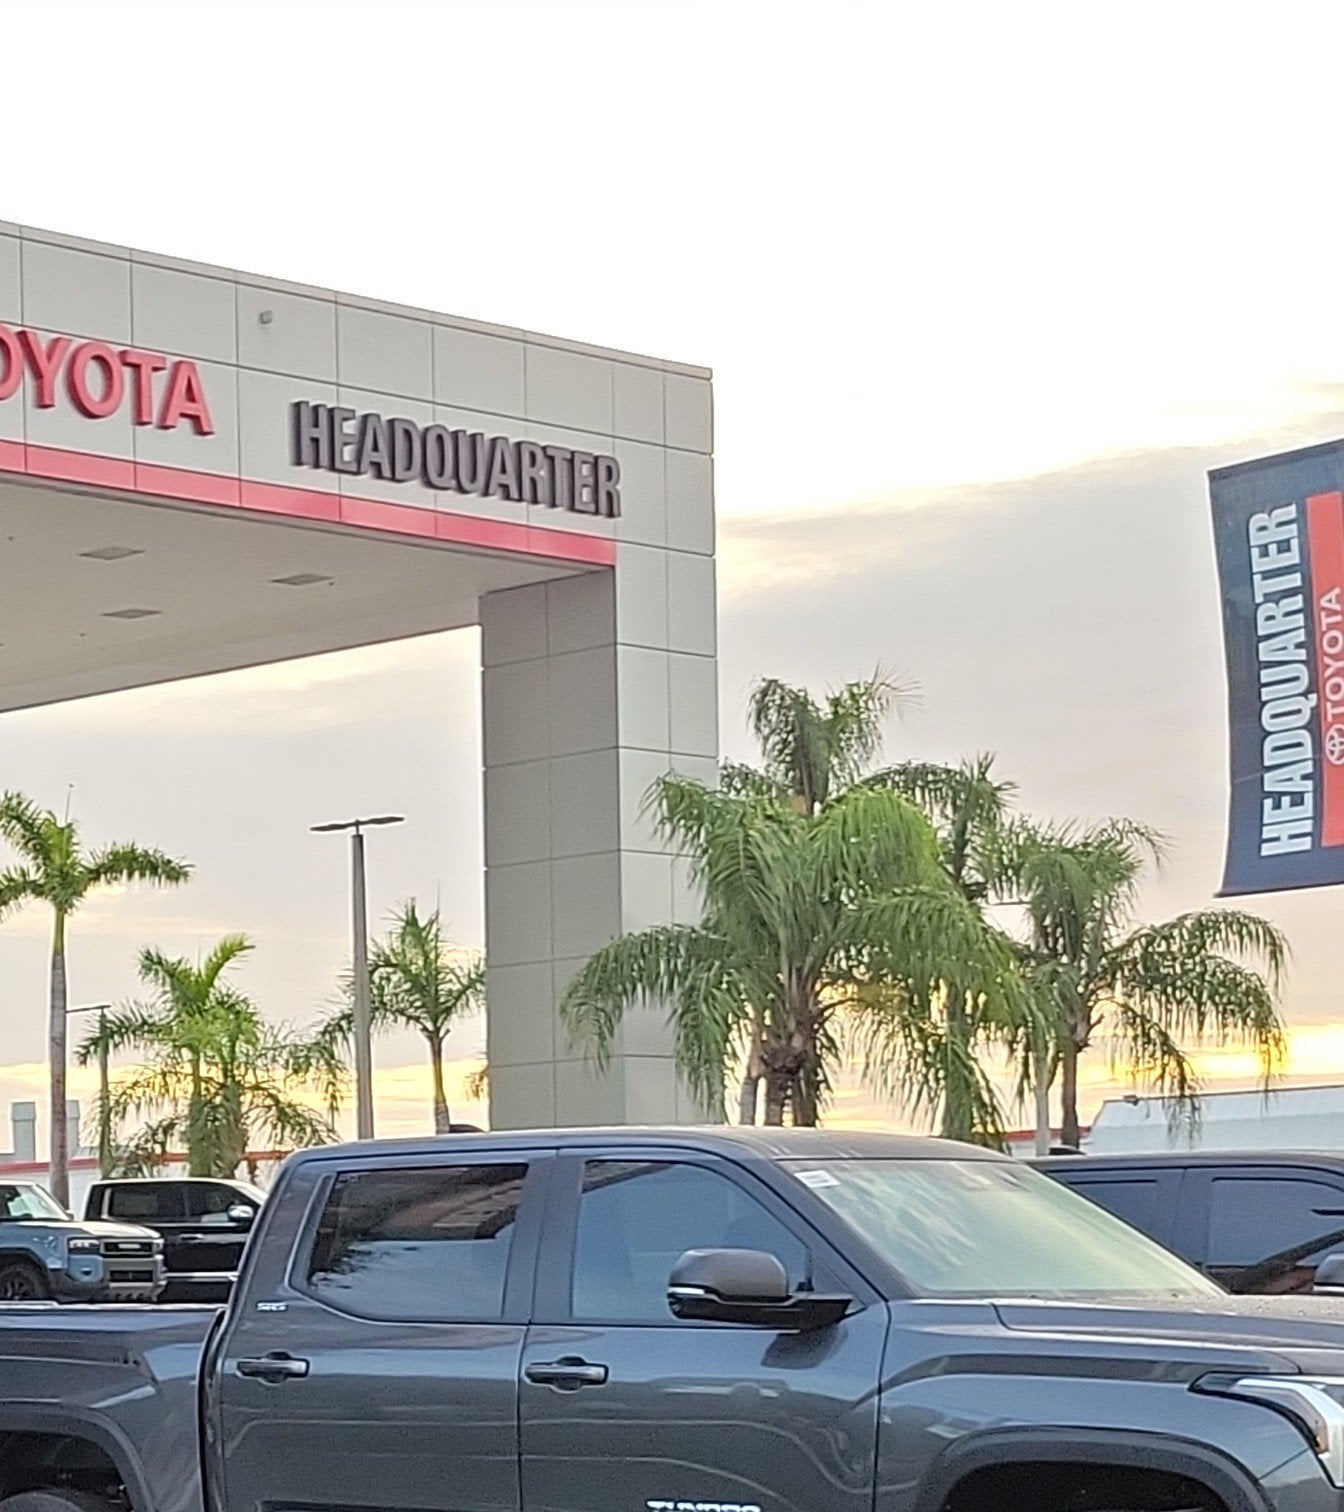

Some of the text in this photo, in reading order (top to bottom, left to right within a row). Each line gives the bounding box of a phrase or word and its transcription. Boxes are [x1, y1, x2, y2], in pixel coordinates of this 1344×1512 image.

[290, 400, 623, 518] HEADQUARTER
[1248, 503, 1318, 857] HEADQUARTER
[1320, 587, 1344, 722] TOYOTA
